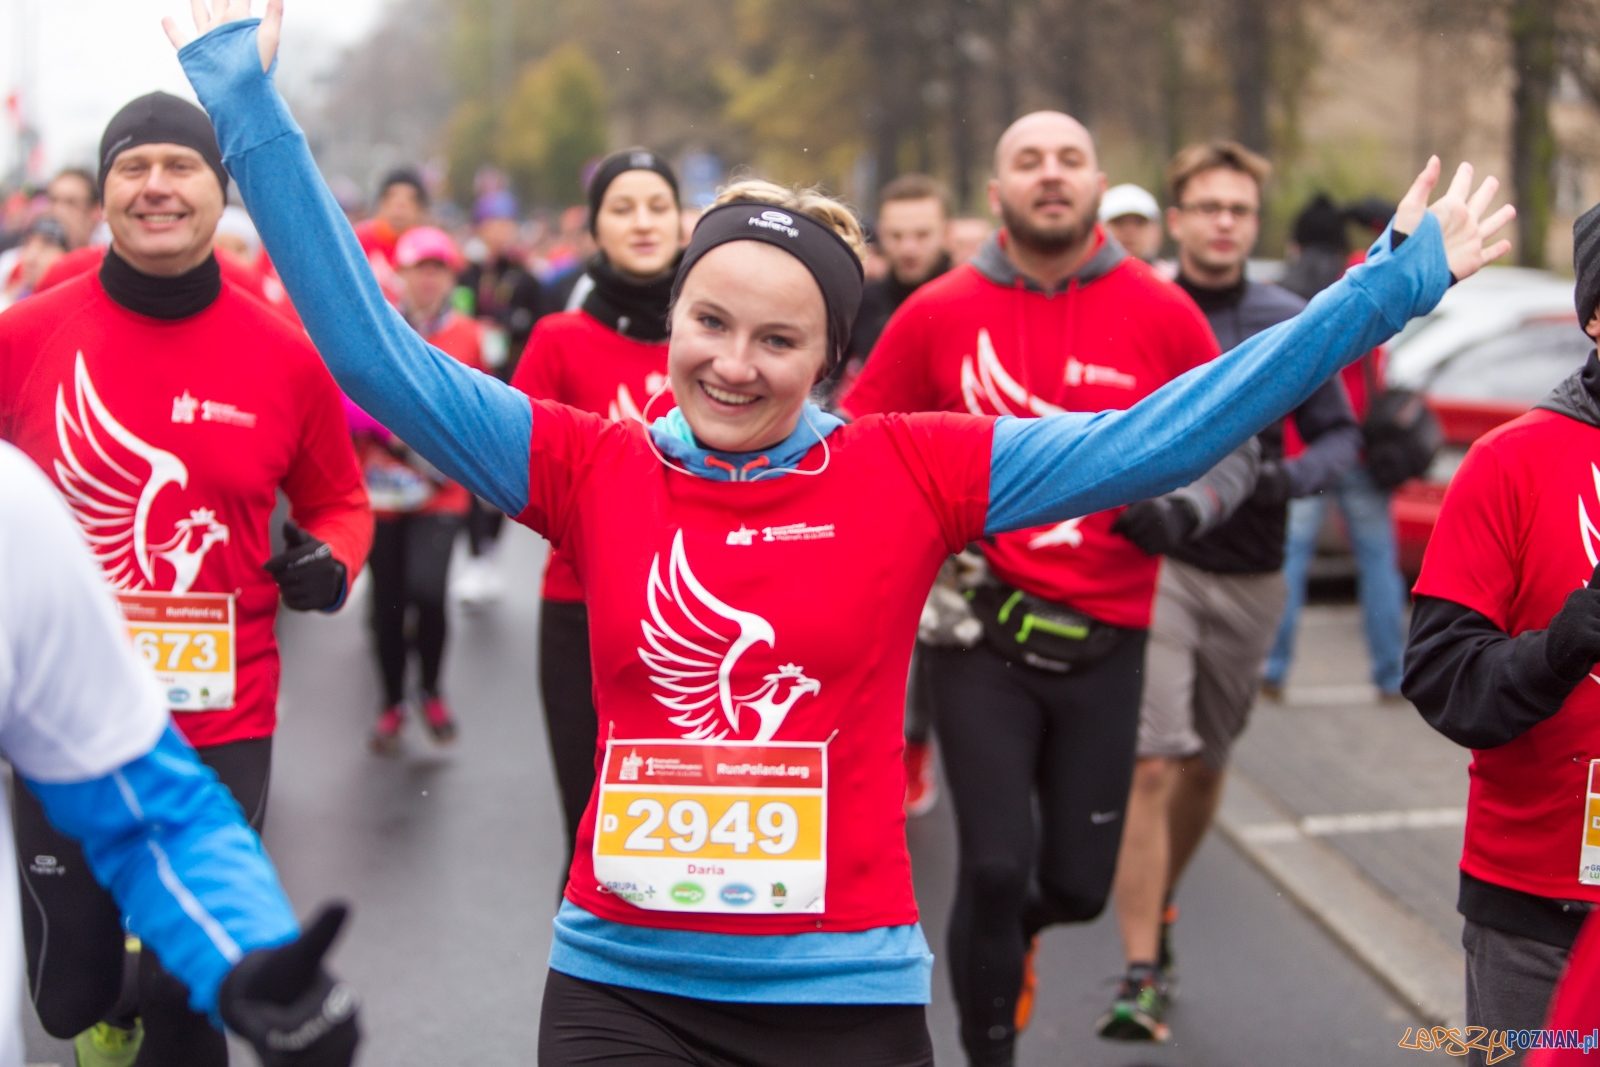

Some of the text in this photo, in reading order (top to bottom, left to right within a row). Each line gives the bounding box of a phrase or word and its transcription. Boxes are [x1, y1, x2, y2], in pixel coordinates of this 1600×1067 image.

[762, 526, 775, 542] 1
[717, 763, 809, 779] RunPoland.org
[603, 798, 799, 855] D 2949
[687, 864, 725, 876] Daria
